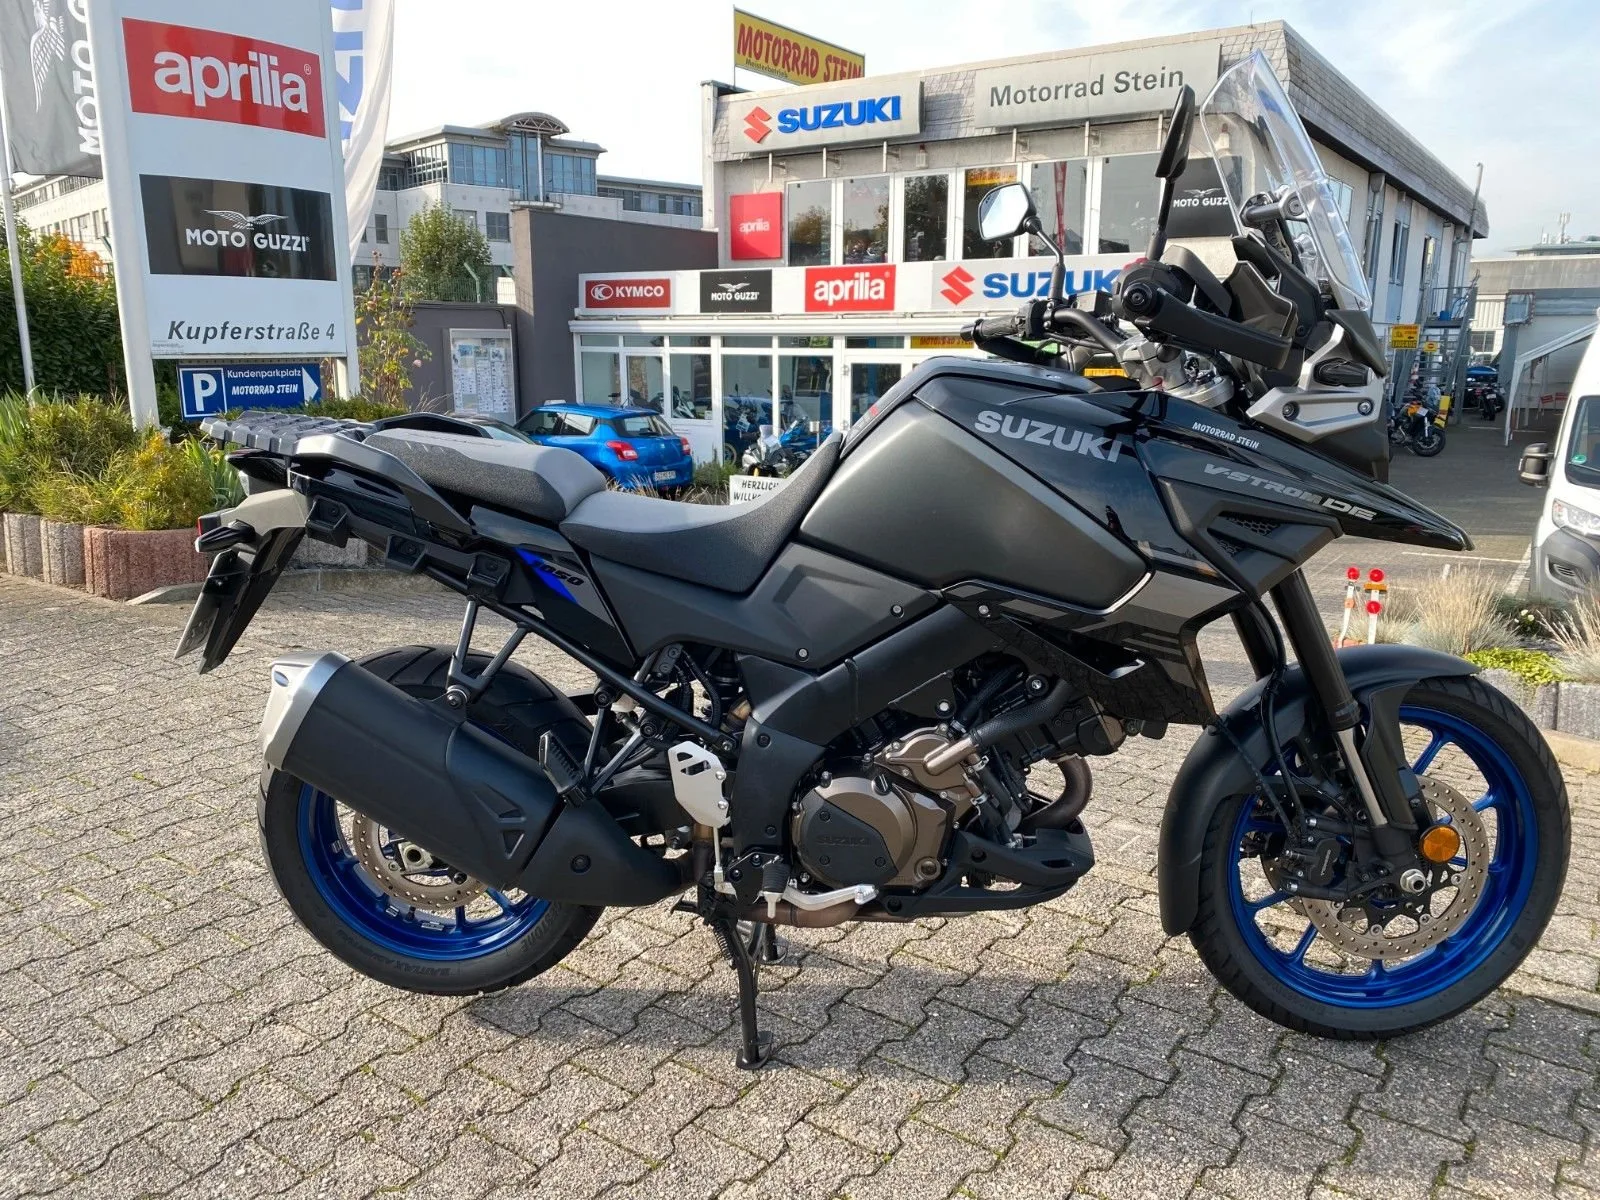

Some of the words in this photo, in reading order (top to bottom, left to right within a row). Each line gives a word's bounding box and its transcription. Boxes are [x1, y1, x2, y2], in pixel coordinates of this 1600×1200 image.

[737, 23, 819, 78] MOTORRAD
[823, 54, 863, 82] STEIN
[154, 51, 308, 113] aprilia
[990, 73, 1104, 107] Motorrad
[1114, 66, 1184, 94] Stein
[70, 39, 101, 156] MOTO
[777, 95, 902, 134] SUZUKI
[1173, 198, 1199, 208] MOTO
[1202, 196, 1229, 207] GUZZ
[185, 228, 246, 248] MOTO
[253, 232, 307, 252] GUZZI
[739, 218, 770, 236] aprilia
[615, 285, 665, 298] KYMCO
[711, 291, 732, 301] MOTO
[734, 291, 759, 301] GUZZI
[814, 271, 885, 306] aprilia
[983, 269, 1122, 299] SUZUK
[168, 320, 320, 344] Kupferstraße
[326, 323, 335, 340] 4
[227, 367, 302, 379] Kundenparkplatz
[192, 373, 217, 412] P
[231, 384, 274, 396] MOTORRAD
[276, 383, 299, 394] STEIN
[974, 410, 1122, 463] SUZUKI
[1192, 421, 1236, 442] MOTORRAD
[1236, 435, 1260, 450] STEIN
[1204, 463, 1324, 506] V-STROM
[1322, 497, 1378, 521] DE
